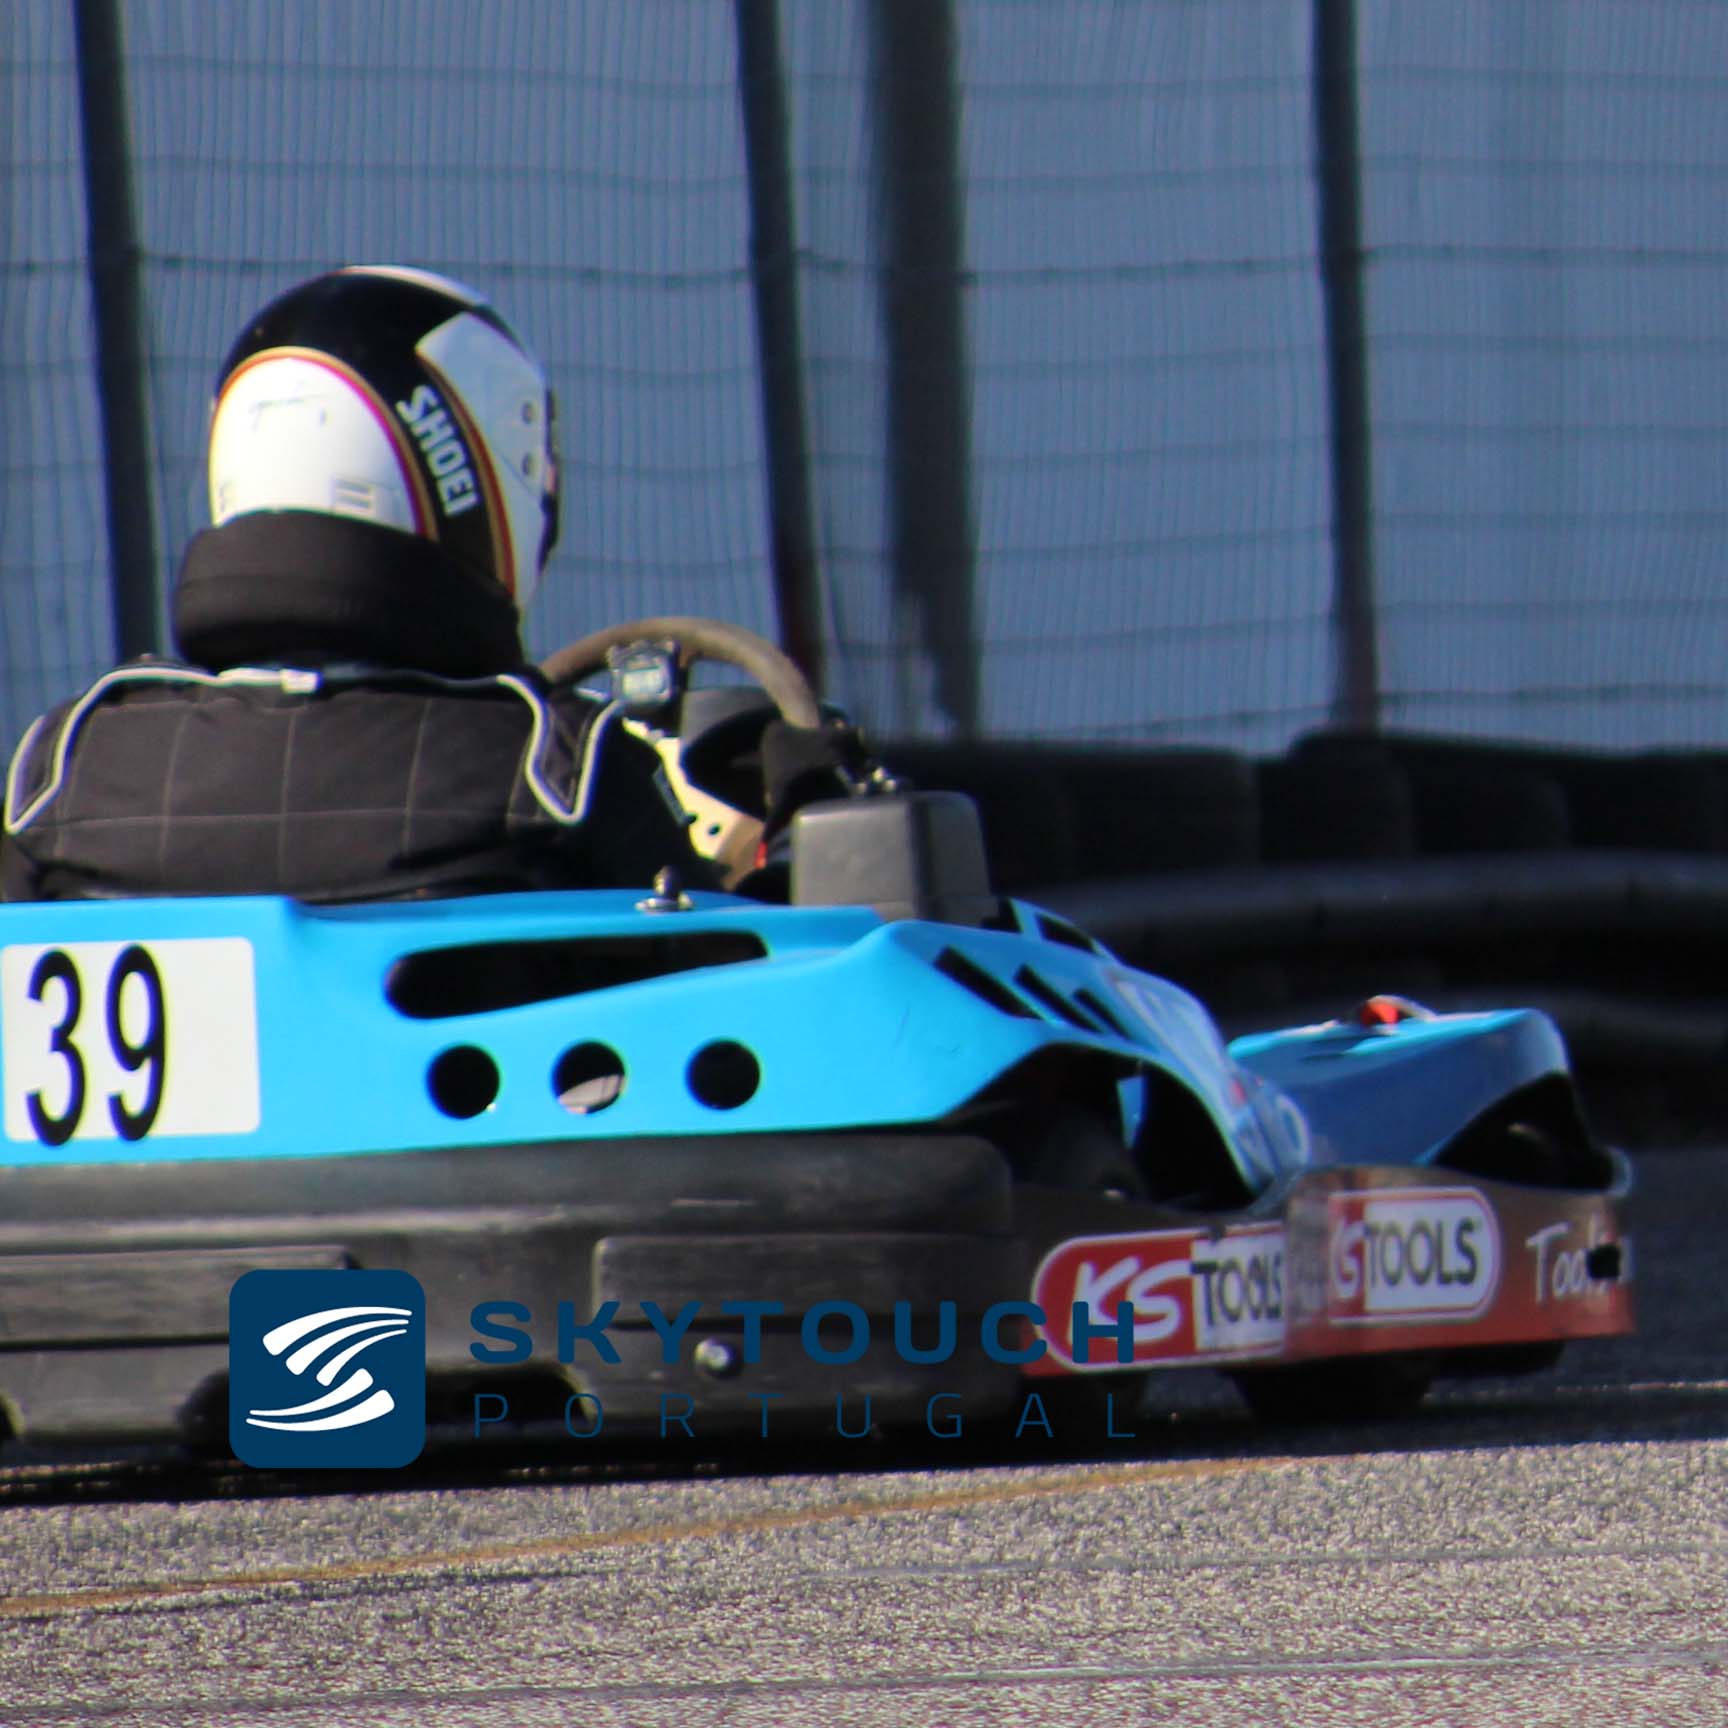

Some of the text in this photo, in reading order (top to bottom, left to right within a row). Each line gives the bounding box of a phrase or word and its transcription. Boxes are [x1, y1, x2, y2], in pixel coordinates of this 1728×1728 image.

[395, 384, 479, 515] SHOEI
[26, 944, 166, 1146] 39
[1068, 1256, 1190, 1343] KS
[1364, 1218, 1478, 1288] TOOLS
